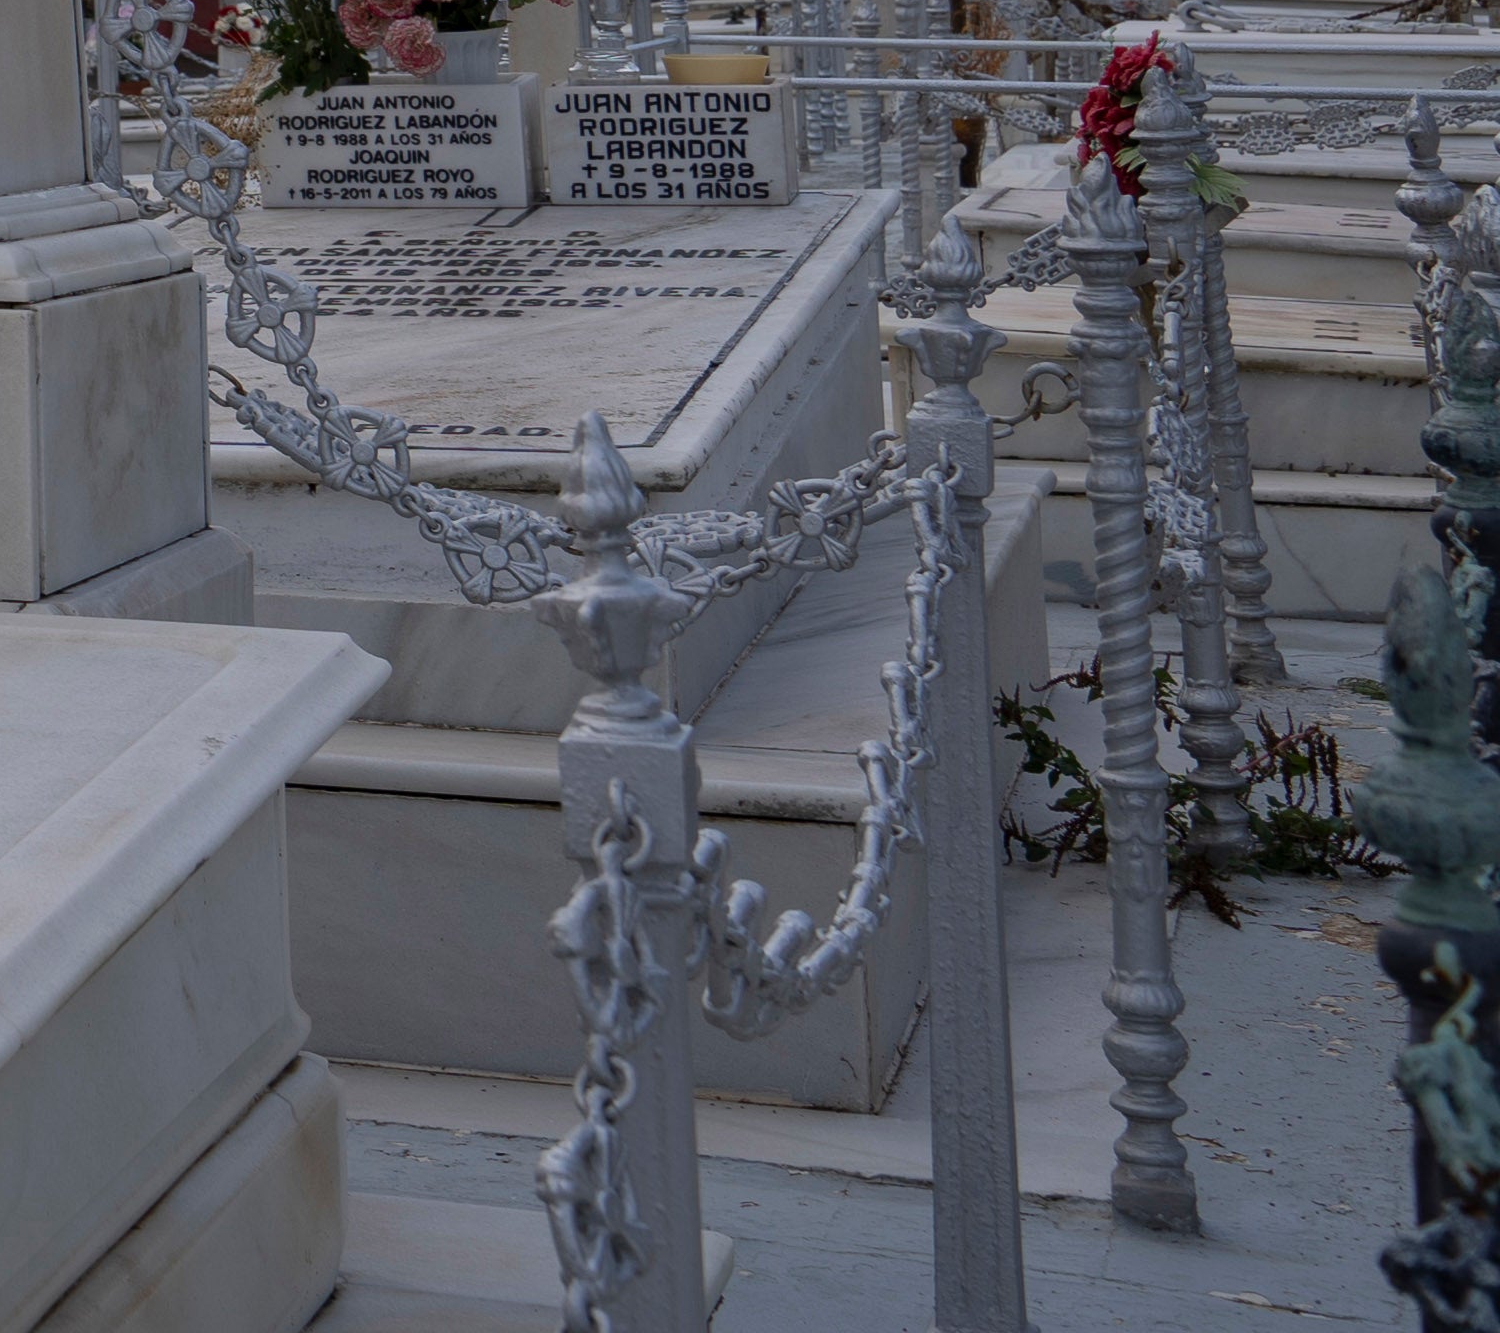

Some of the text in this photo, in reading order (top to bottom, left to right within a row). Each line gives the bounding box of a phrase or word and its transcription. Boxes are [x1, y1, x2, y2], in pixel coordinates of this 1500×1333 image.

[316, 94, 457, 111] JUAN ANTONIO
[554, 91, 772, 114] JUAN ANTONIO
[277, 107, 498, 130] RODRIGUEZ LABANDÓN
[579, 116, 750, 137] RODRIGUEZ
[330, 133, 369, 146] 1988
[373, 133, 386, 146] A
[389, 133, 422, 146] LOS
[426, 133, 444, 145] 31
[449, 129, 493, 145] AÑOS
[348, 148, 431, 165] JOAQUIN
[586, 138, 749, 161] LABANDON
[306, 168, 476, 184] RODRIGUEZ ROYO
[299, 184, 499, 201] 16-5-2011 A LOS 79 AÑOS
[569, 177, 771, 200] A LOS 31 AÑOS
[319, 246, 795, 260] SANCHEZ FERNANDEZ.
[293, 258, 533, 268] DICIEMBRE
[300, 267, 361, 277] DE
[580, 285, 761, 299] RIVERA.
